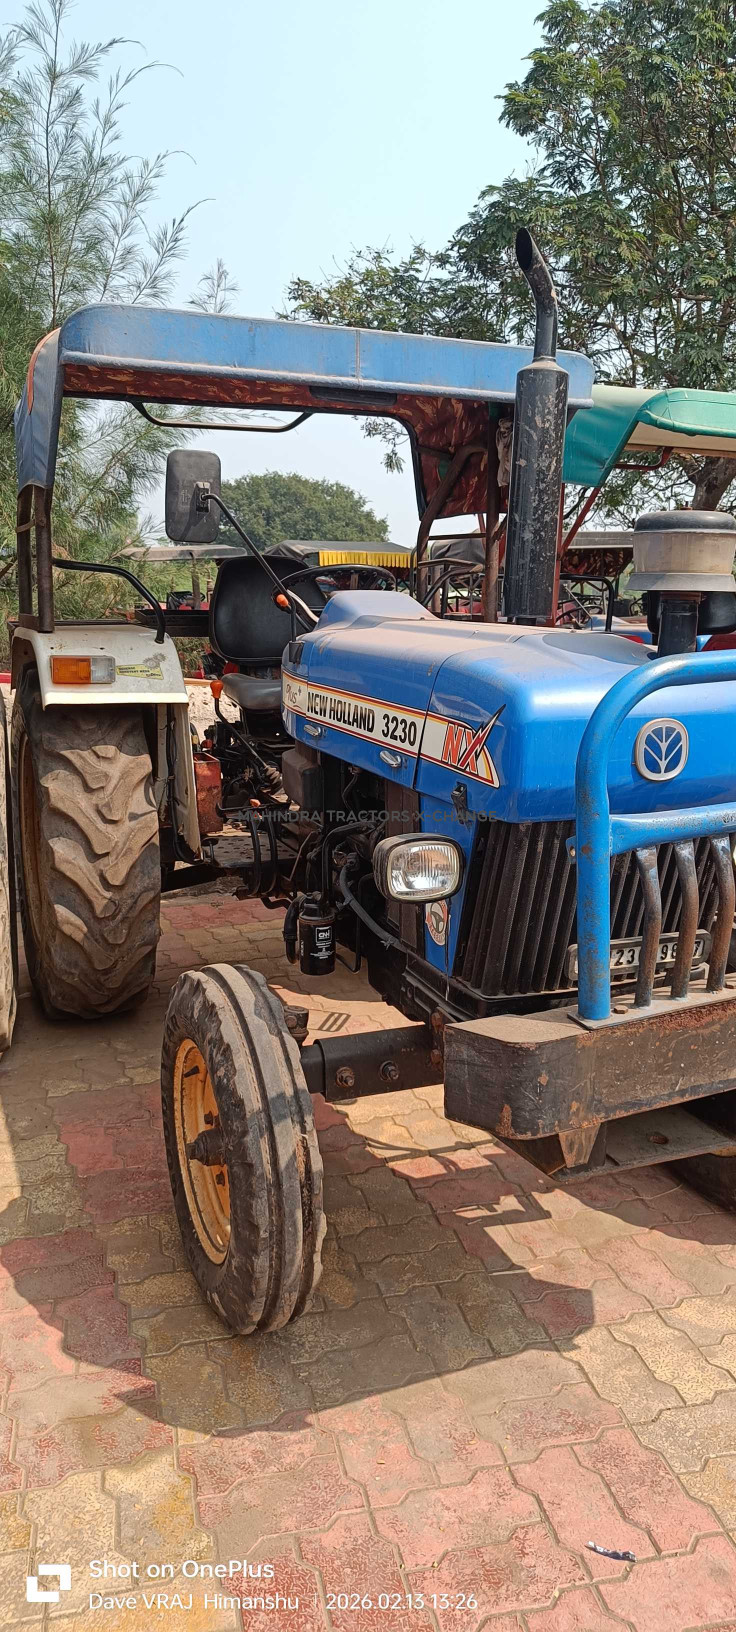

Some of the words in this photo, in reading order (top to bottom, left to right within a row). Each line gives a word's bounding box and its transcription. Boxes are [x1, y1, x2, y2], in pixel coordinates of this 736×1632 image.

[307, 692, 327, 717] NEW
[328, 698, 376, 733] HOLLAND
[381, 714, 417, 747] 3230
[441, 710, 500, 775] NX
[614, 949, 635, 966] 23
